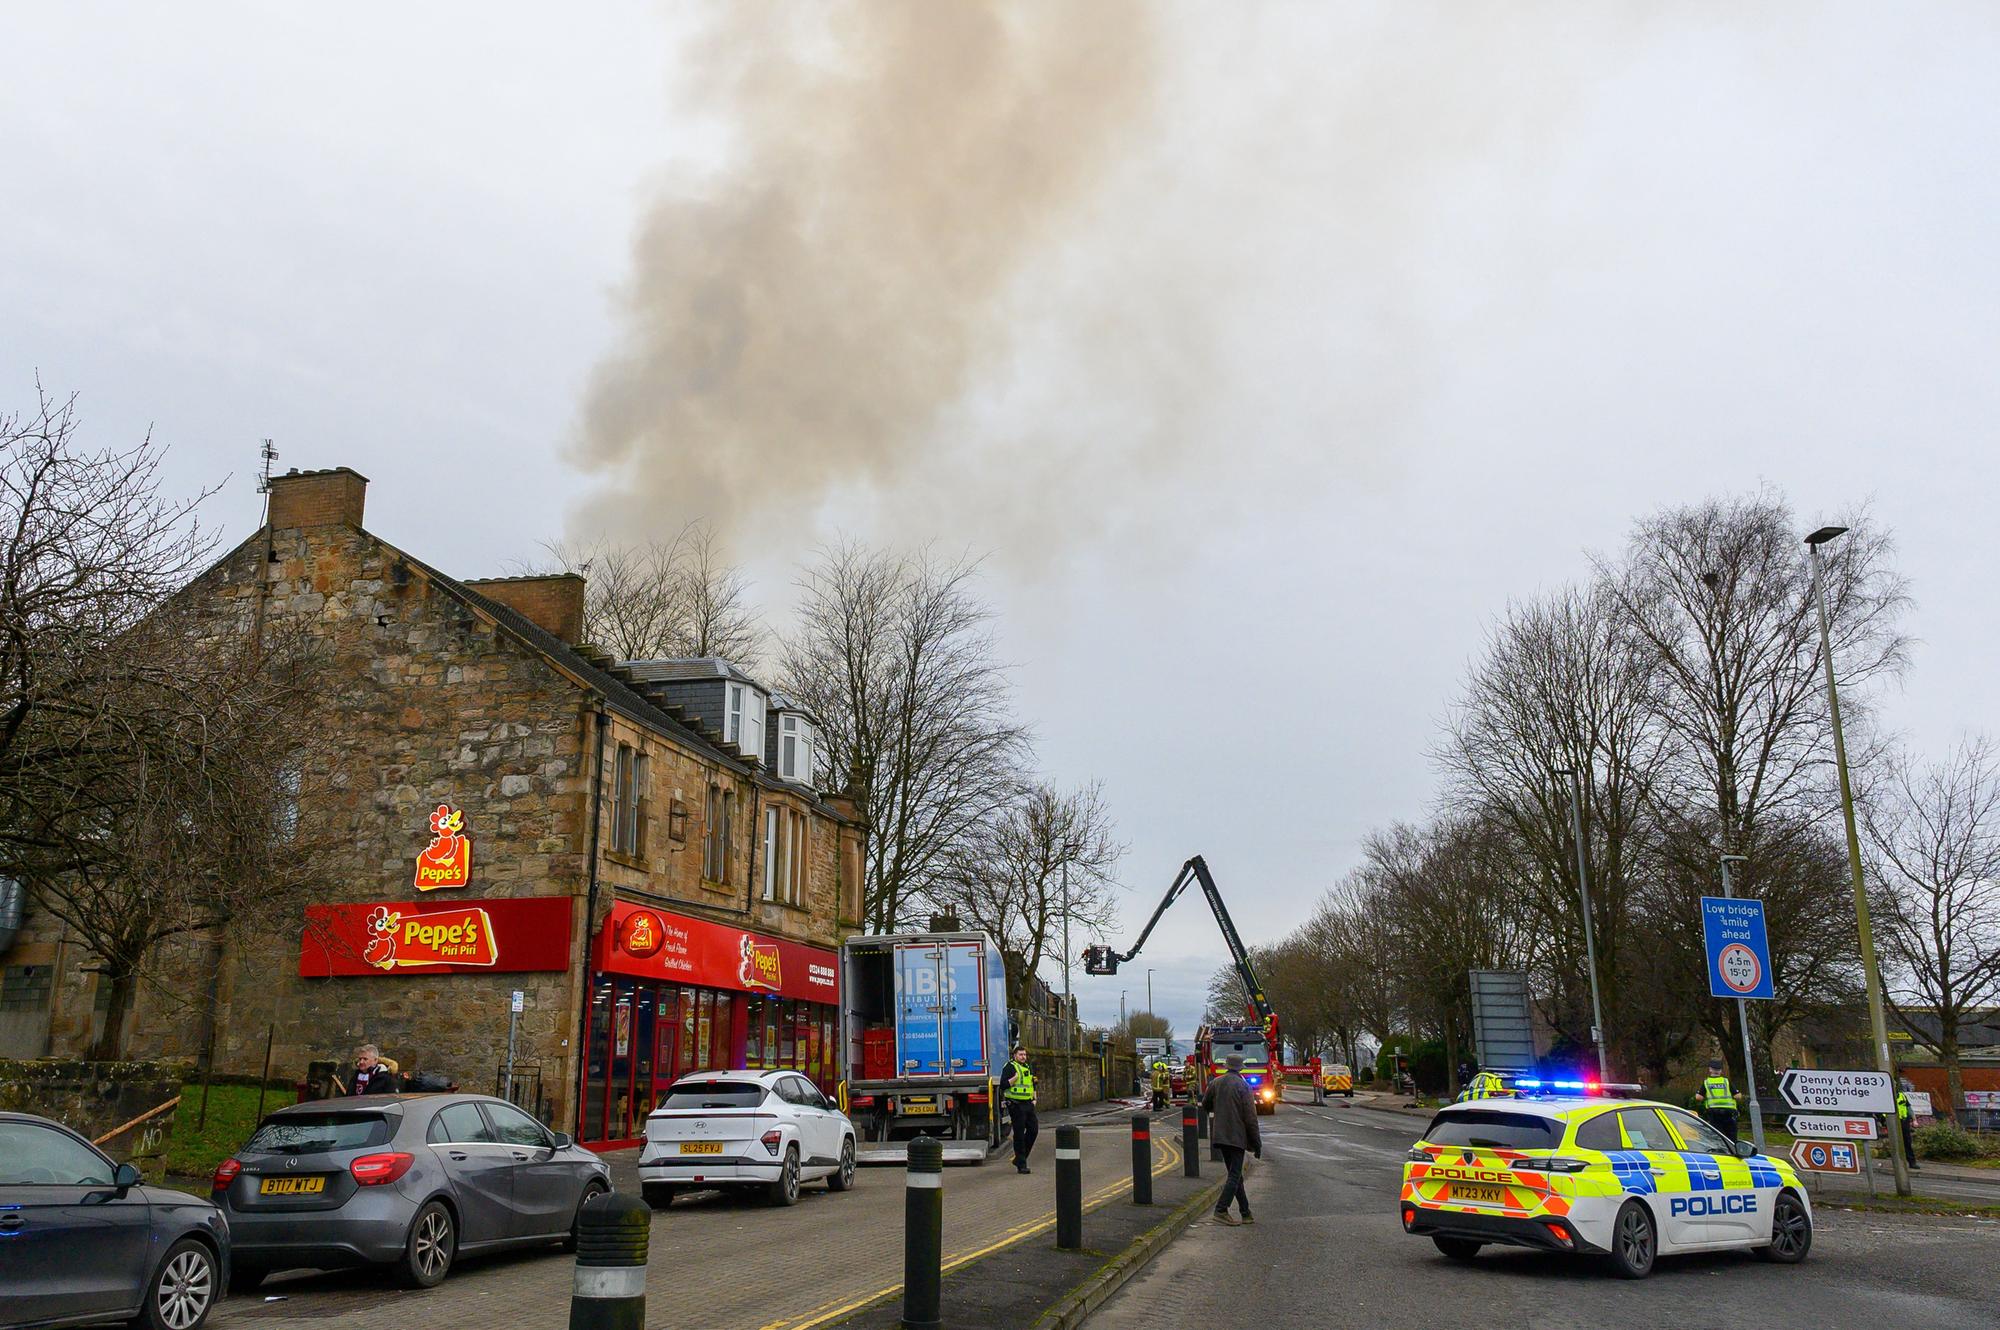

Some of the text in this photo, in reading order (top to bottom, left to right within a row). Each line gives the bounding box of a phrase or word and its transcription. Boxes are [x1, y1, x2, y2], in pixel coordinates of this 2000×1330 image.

[421, 865, 461, 883] Pepe's
[1706, 903, 1759, 917] Low bridge
[1728, 917, 1749, 927] mile
[404, 917, 478, 951] Pepe's
[1721, 929, 1751, 939] ahead
[441, 945, 477, 956] Piri Piri
[755, 950, 777, 975] Pepe's
[1800, 1075, 1885, 1087] Denny (A 883)
[1801, 1086, 1870, 1098] Bonnybridge
[1803, 1097, 1838, 1105] A 803
[1800, 1122, 1840, 1132] Station
[141, 1128, 162, 1151] NO
[683, 1144, 720, 1153] SL25 FVJ
[1431, 1168, 1512, 1182] POLICE
[268, 1178, 317, 1191] BT17 WTJ
[1452, 1186, 1500, 1200] MT23 XKY
[1670, 1194, 1757, 1217] POLICE
